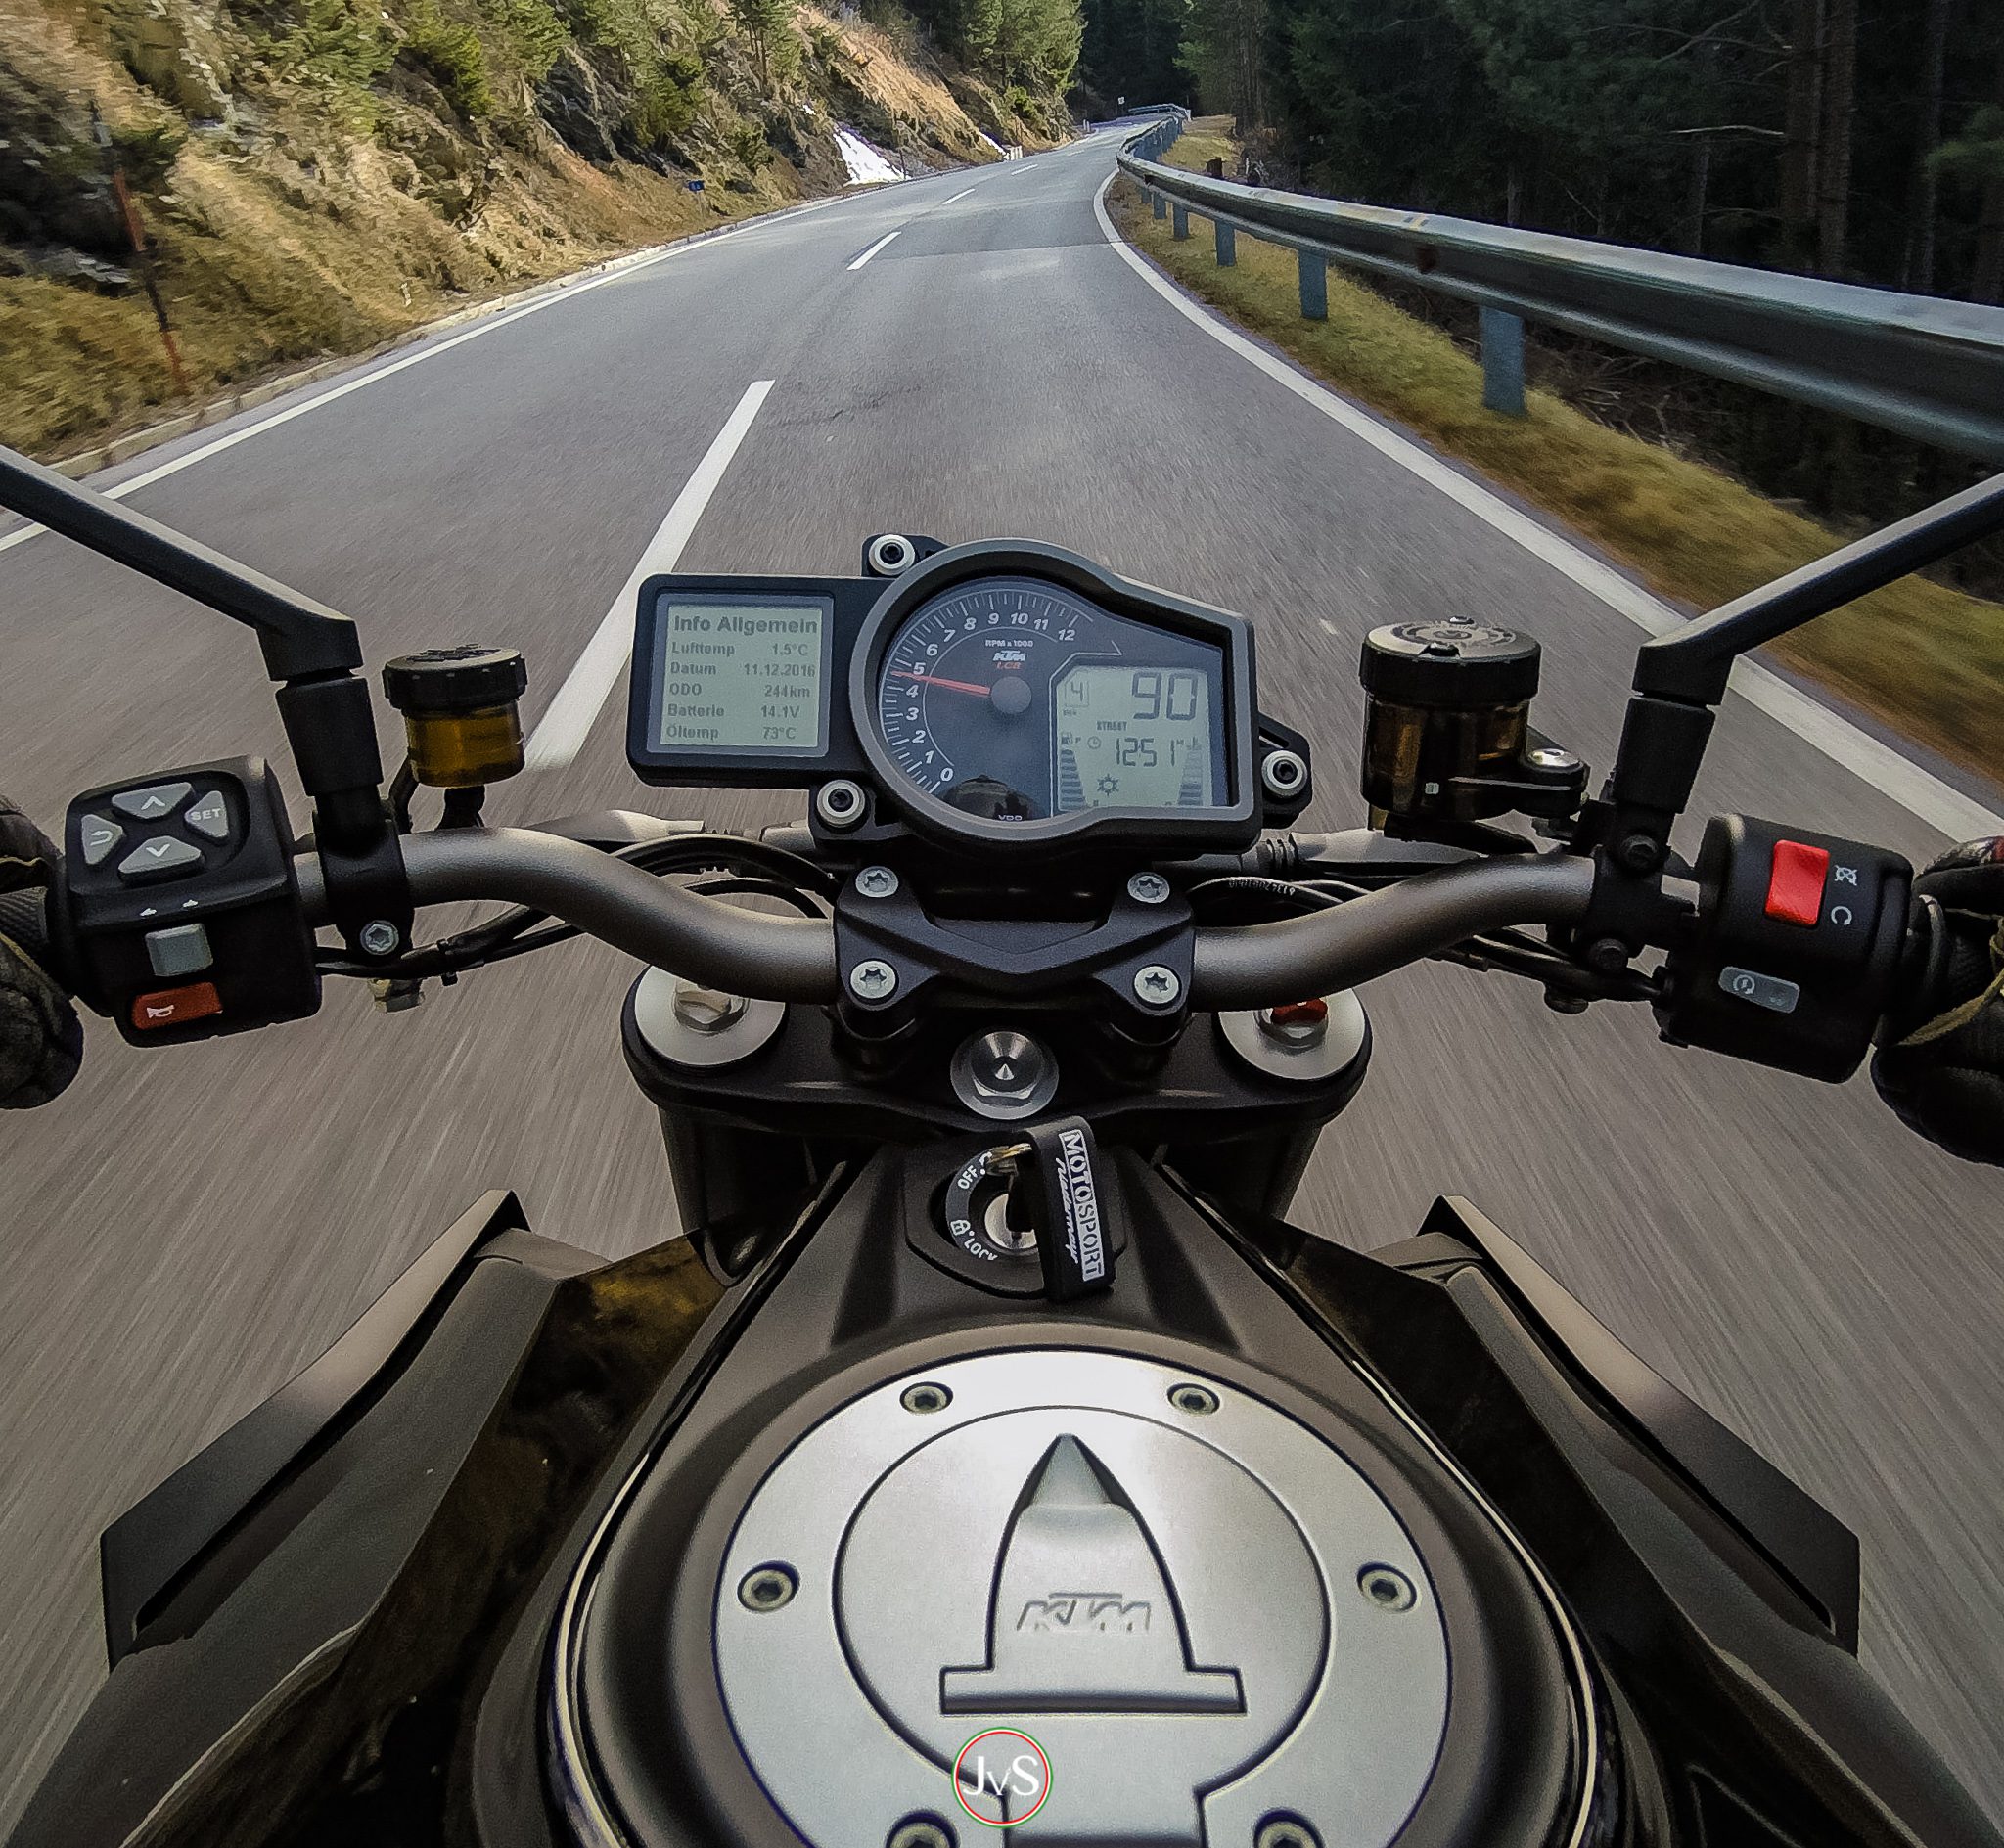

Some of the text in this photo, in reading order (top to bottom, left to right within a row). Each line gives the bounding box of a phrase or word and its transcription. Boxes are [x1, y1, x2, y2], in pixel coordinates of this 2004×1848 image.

[674, 615, 818, 636] Info Allgemein
[964, 617, 977, 631] 8
[988, 613, 999, 625] 9
[1010, 613, 1028, 625] 10
[1033, 618, 1049, 630] 11
[943, 629, 956, 643] 7
[1058, 629, 1076, 641] 12
[671, 642, 735, 657] Lufttemp
[926, 644, 938, 656] 6
[992, 650, 1026, 662] KTM
[670, 661, 816, 678] Datum 11.12.2016
[913, 662, 926, 675] 5
[669, 682, 702, 696] ODO
[906, 685, 919, 698] 4
[1070, 681, 1084, 702] 4
[1132, 672, 1199, 721] 90
[667, 703, 800, 718] Batterie 14.1V
[906, 707, 920, 720] 3
[762, 726, 797, 740] 73°C
[912, 730, 926, 744] 2
[925, 750, 934, 764] 1
[940, 768, 954, 782] 0
[190, 807, 221, 822] SET
[957, 1164, 979, 1190] OFF
[1063, 1131, 1103, 1275] MOTOSPORT
[1016, 1591, 1152, 1632] KTM
